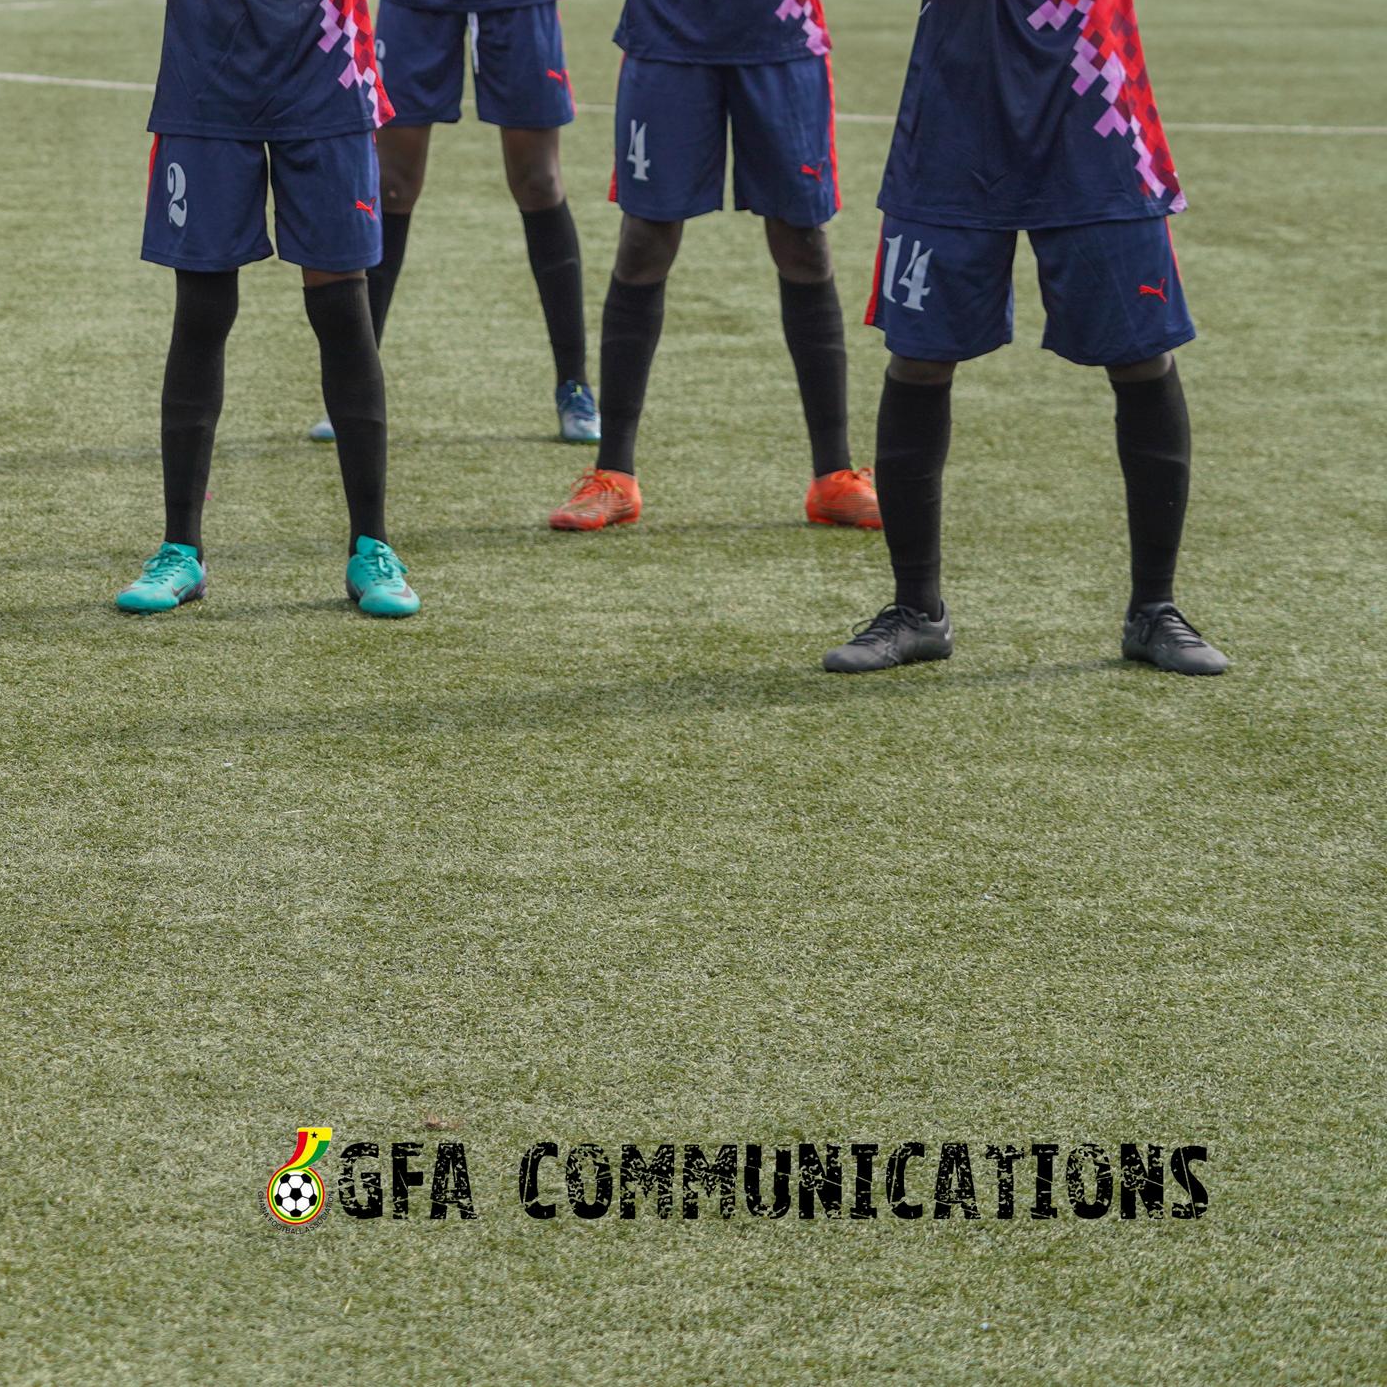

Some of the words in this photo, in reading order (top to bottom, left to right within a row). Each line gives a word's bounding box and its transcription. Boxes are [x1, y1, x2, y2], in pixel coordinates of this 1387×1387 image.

[628, 119, 651, 181] 4
[167, 162, 187, 228] 2
[883, 234, 933, 311] 14
